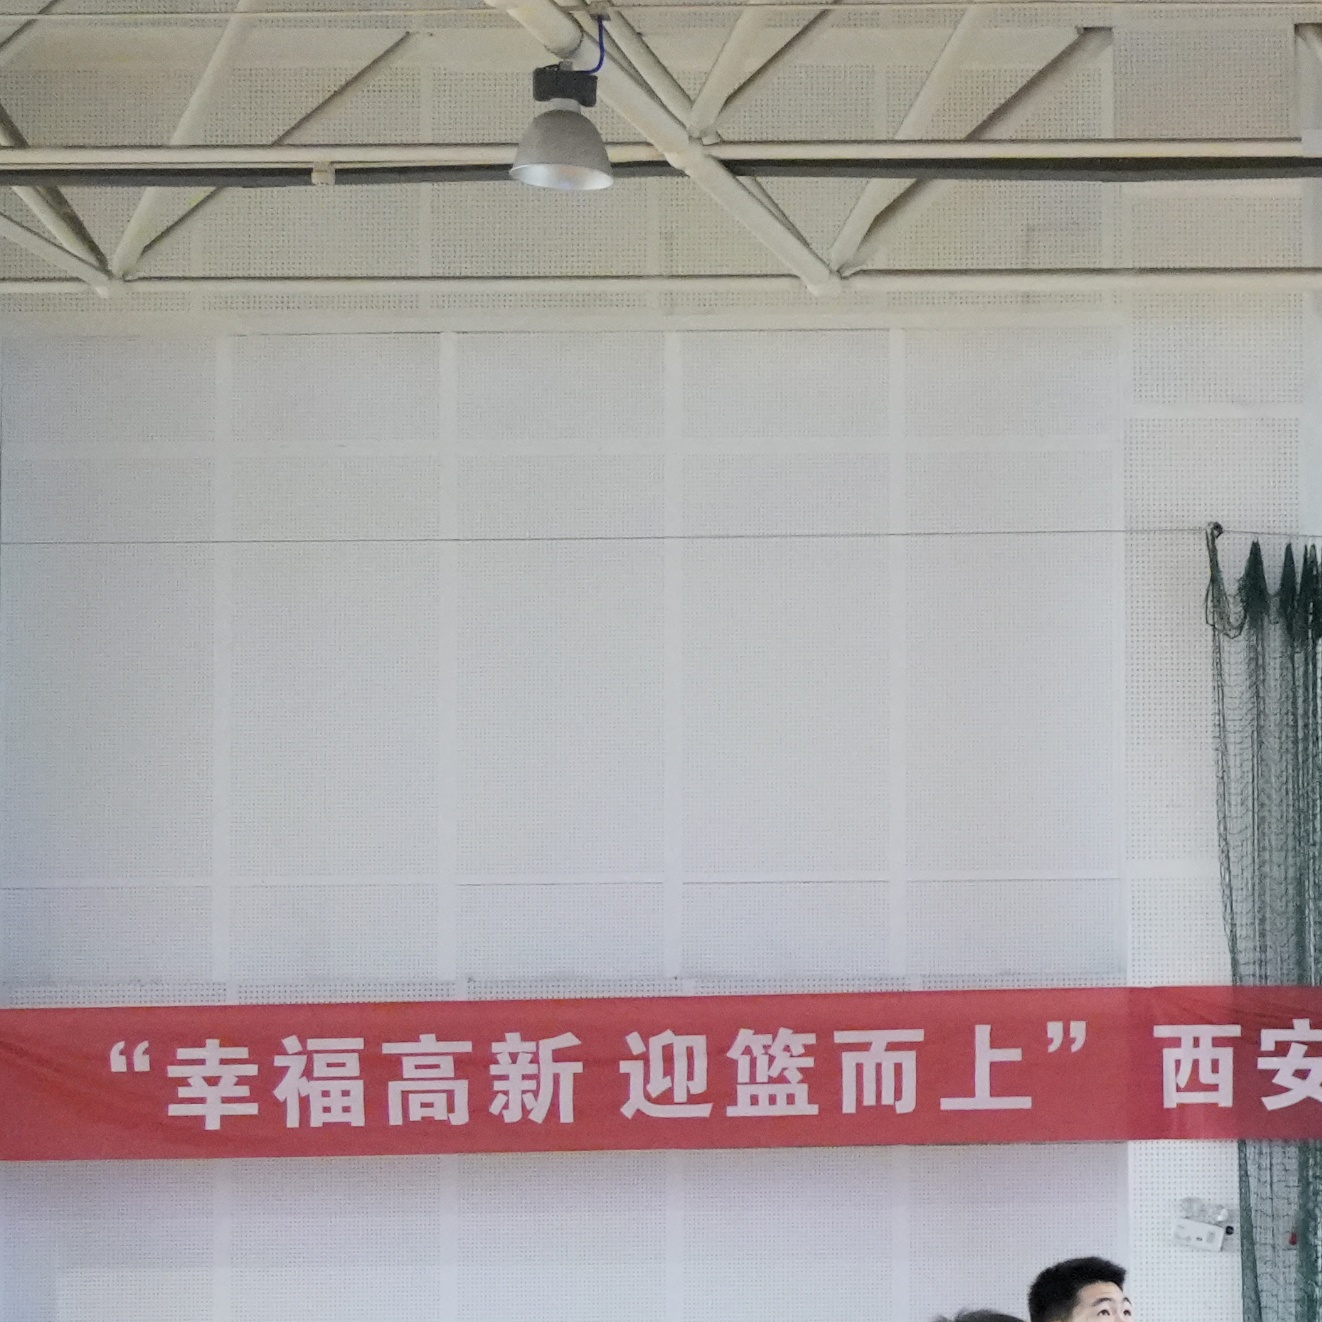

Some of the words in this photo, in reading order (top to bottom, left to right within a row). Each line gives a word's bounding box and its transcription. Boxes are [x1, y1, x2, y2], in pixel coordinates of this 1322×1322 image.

[109, 1032, 585, 1131] “幸福高新
[618, 1020, 1090, 1121] 迎篮而上”
